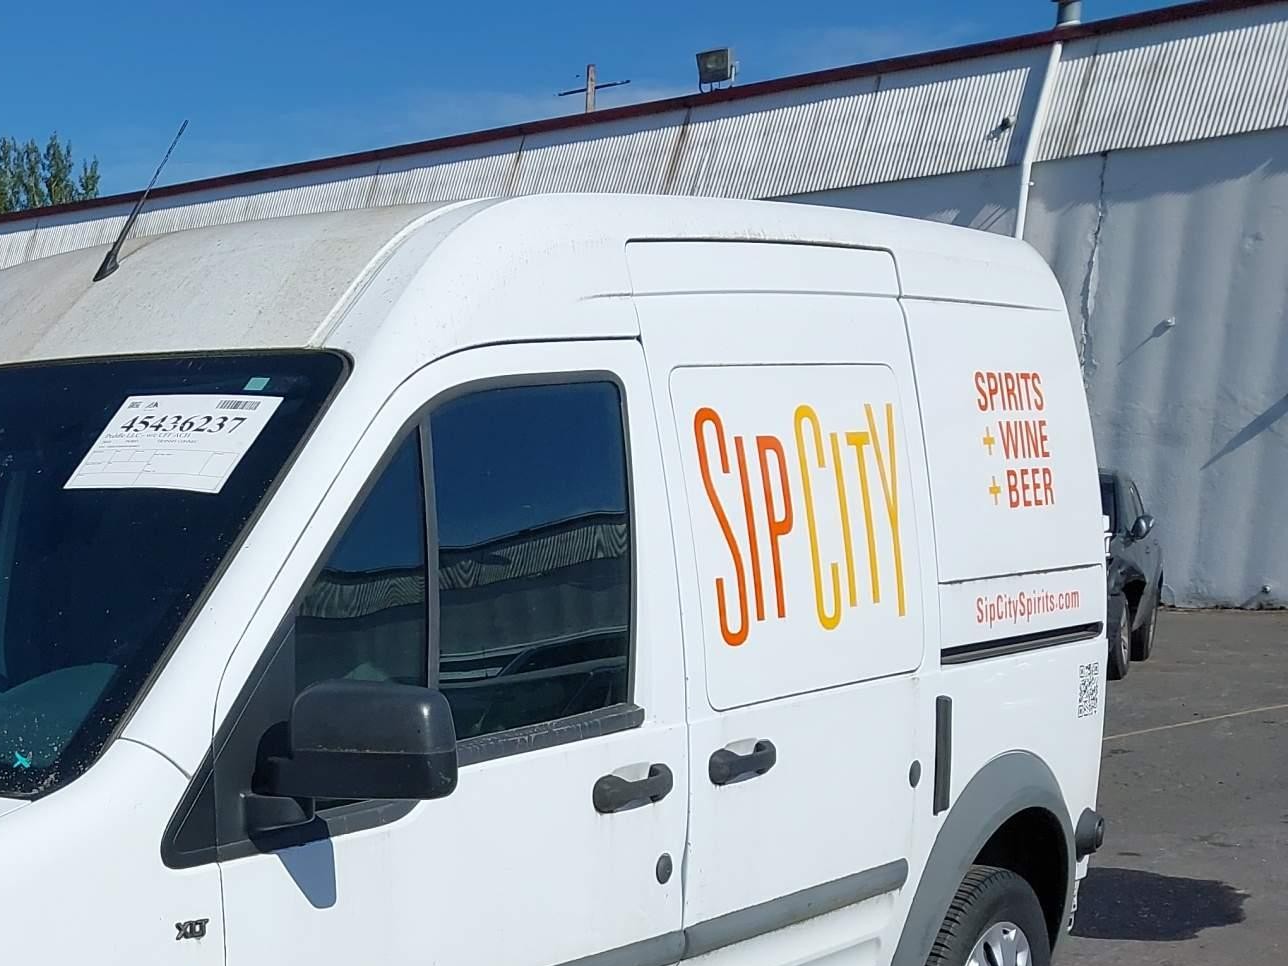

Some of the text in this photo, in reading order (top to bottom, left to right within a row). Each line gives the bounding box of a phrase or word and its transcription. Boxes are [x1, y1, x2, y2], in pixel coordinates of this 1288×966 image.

[974, 371, 1044, 412] SPIRITS
[120, 414, 247, 434] 45436237
[998, 420, 1050, 460] WINE
[1006, 467, 1055, 509] BEER
[976, 588, 1080, 629] SipCitySpirits.com
[175, 918, 209, 941] XLT
